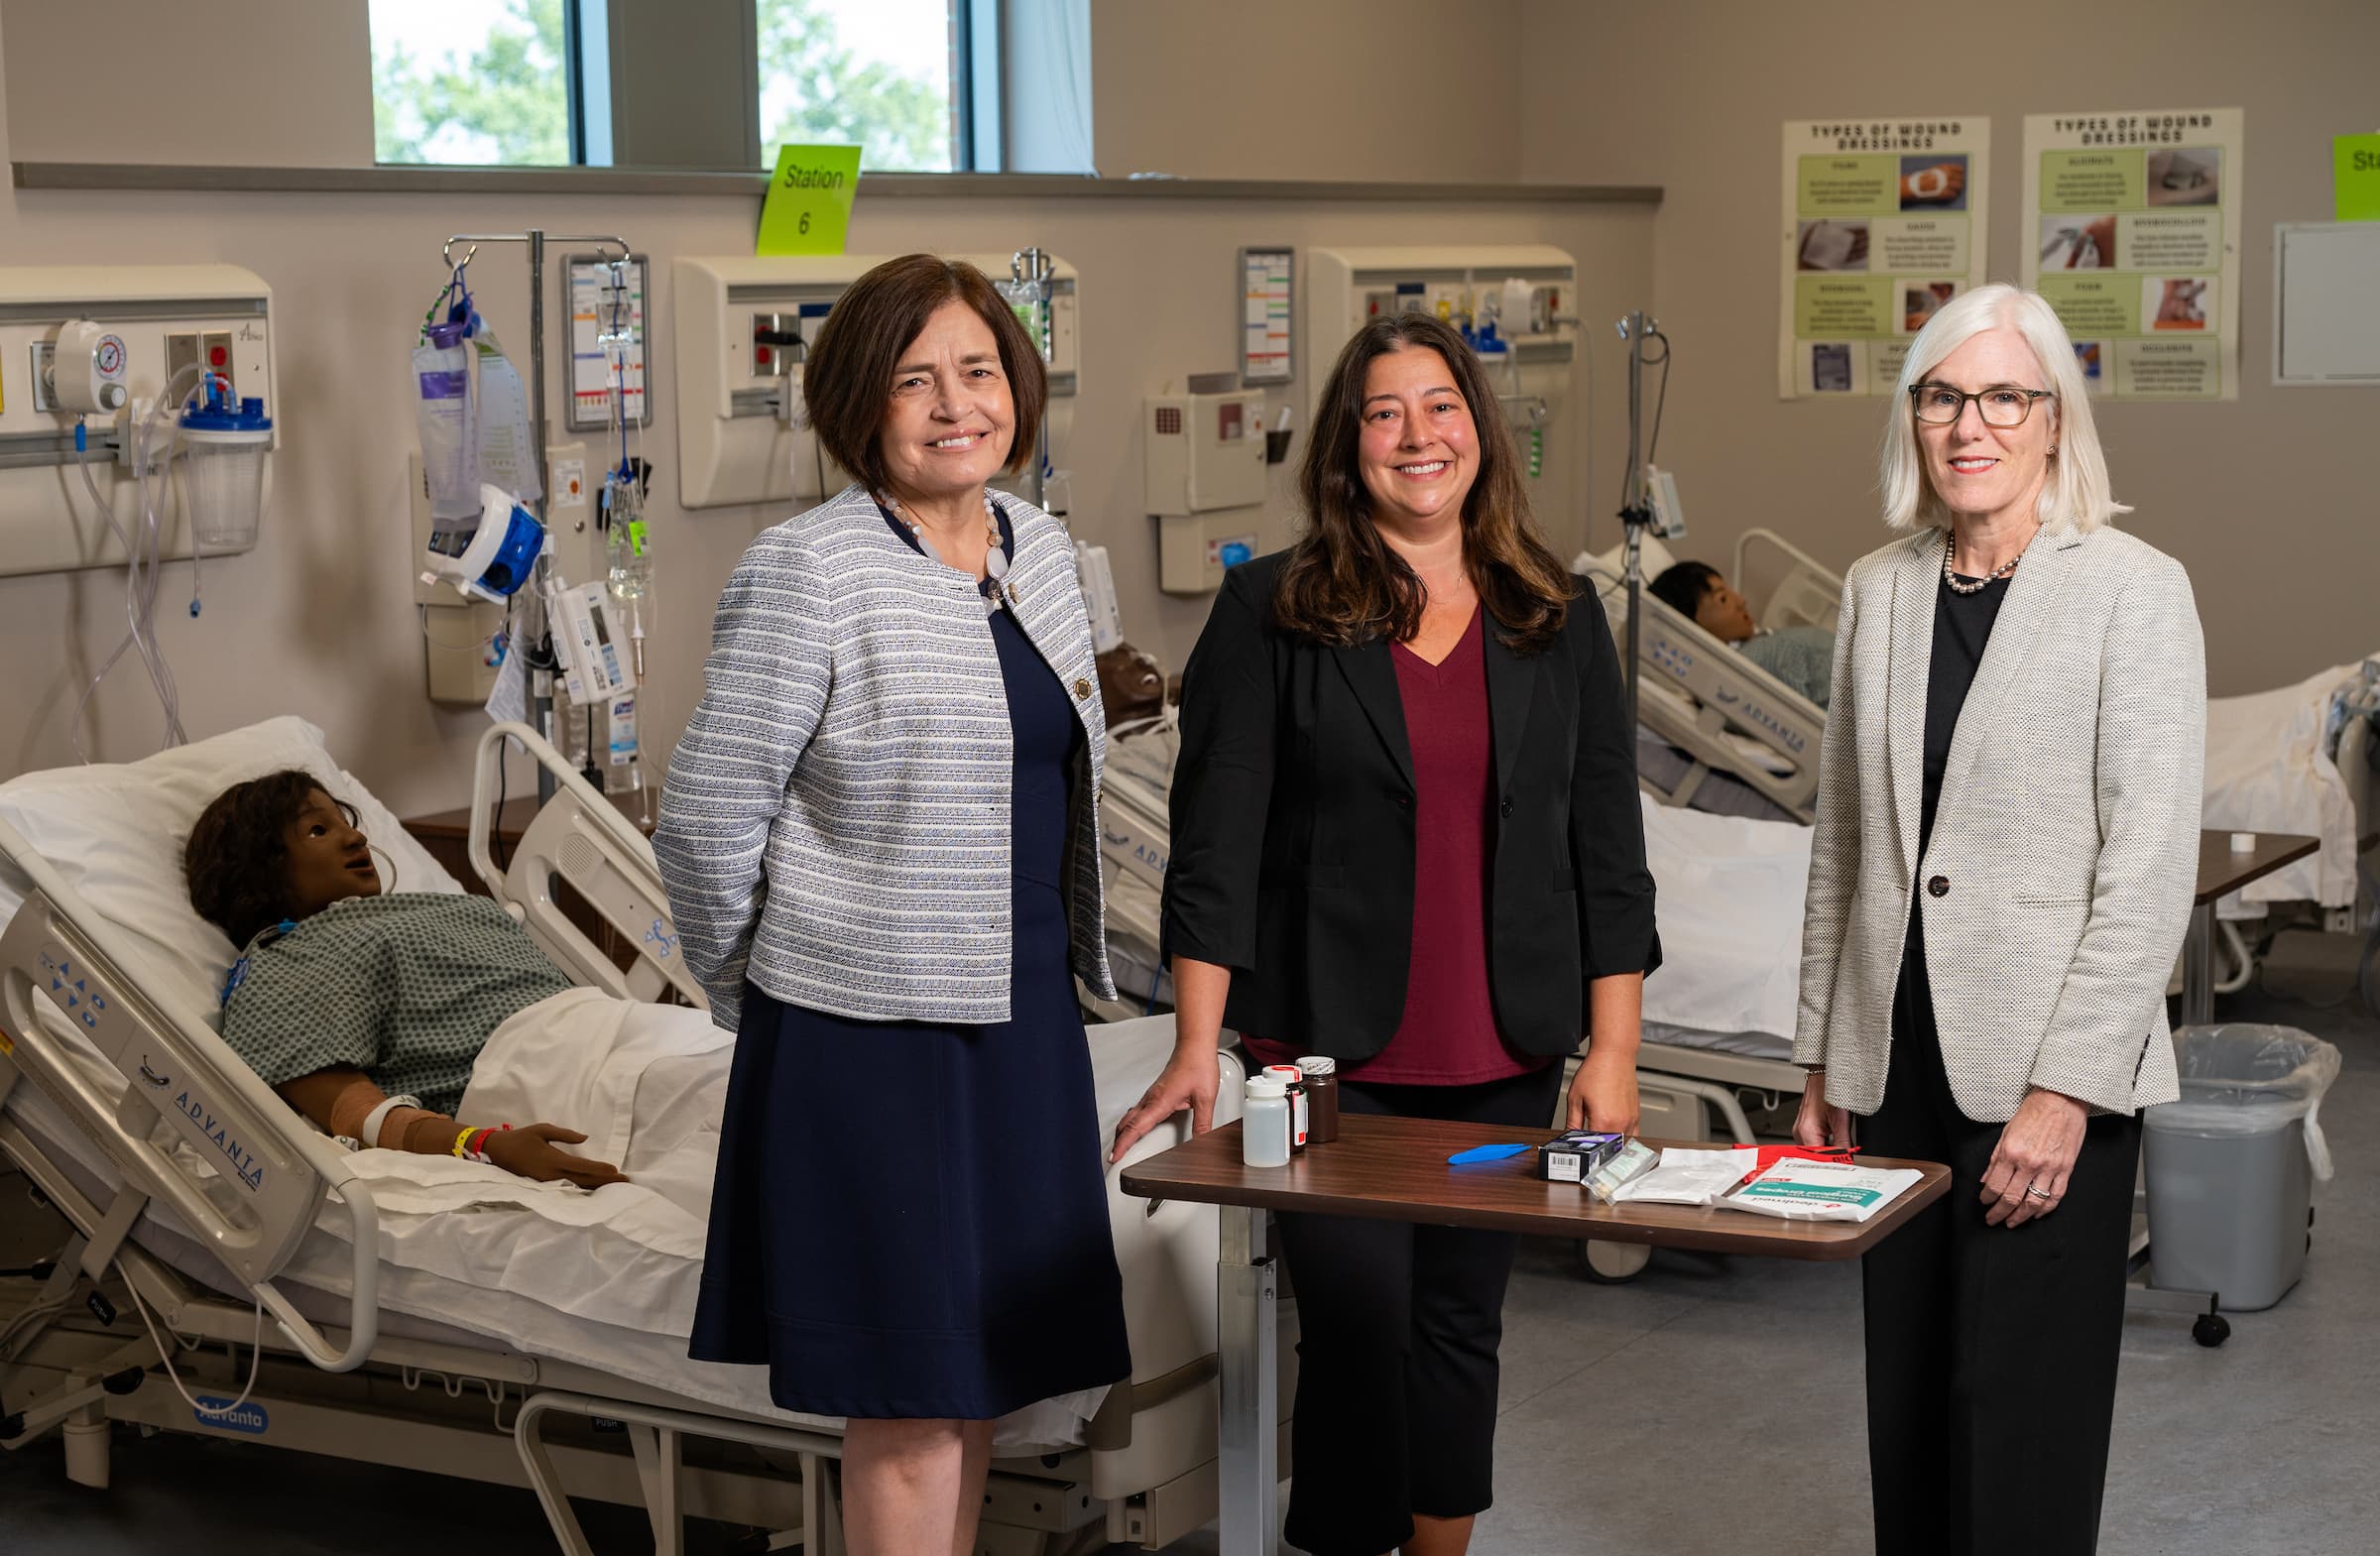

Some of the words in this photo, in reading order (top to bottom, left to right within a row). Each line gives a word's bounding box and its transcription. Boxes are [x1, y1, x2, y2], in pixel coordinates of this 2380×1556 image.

[1811, 123, 1863, 138] TYPES
[1869, 123, 1890, 136] OF
[1898, 121, 1963, 137] WOUND
[2055, 117, 2109, 132] TYPES
[2116, 116, 2138, 130] OF
[2145, 114, 2212, 129] WOUND
[1837, 137, 1935, 152] DRESSINGS
[2082, 130, 2184, 146] DRESSINGS
[783, 164, 845, 190] Station
[797, 211, 812, 236] 6
[176, 1091, 263, 1185] ADVANTA
[198, 1401, 263, 1428] Advanta
